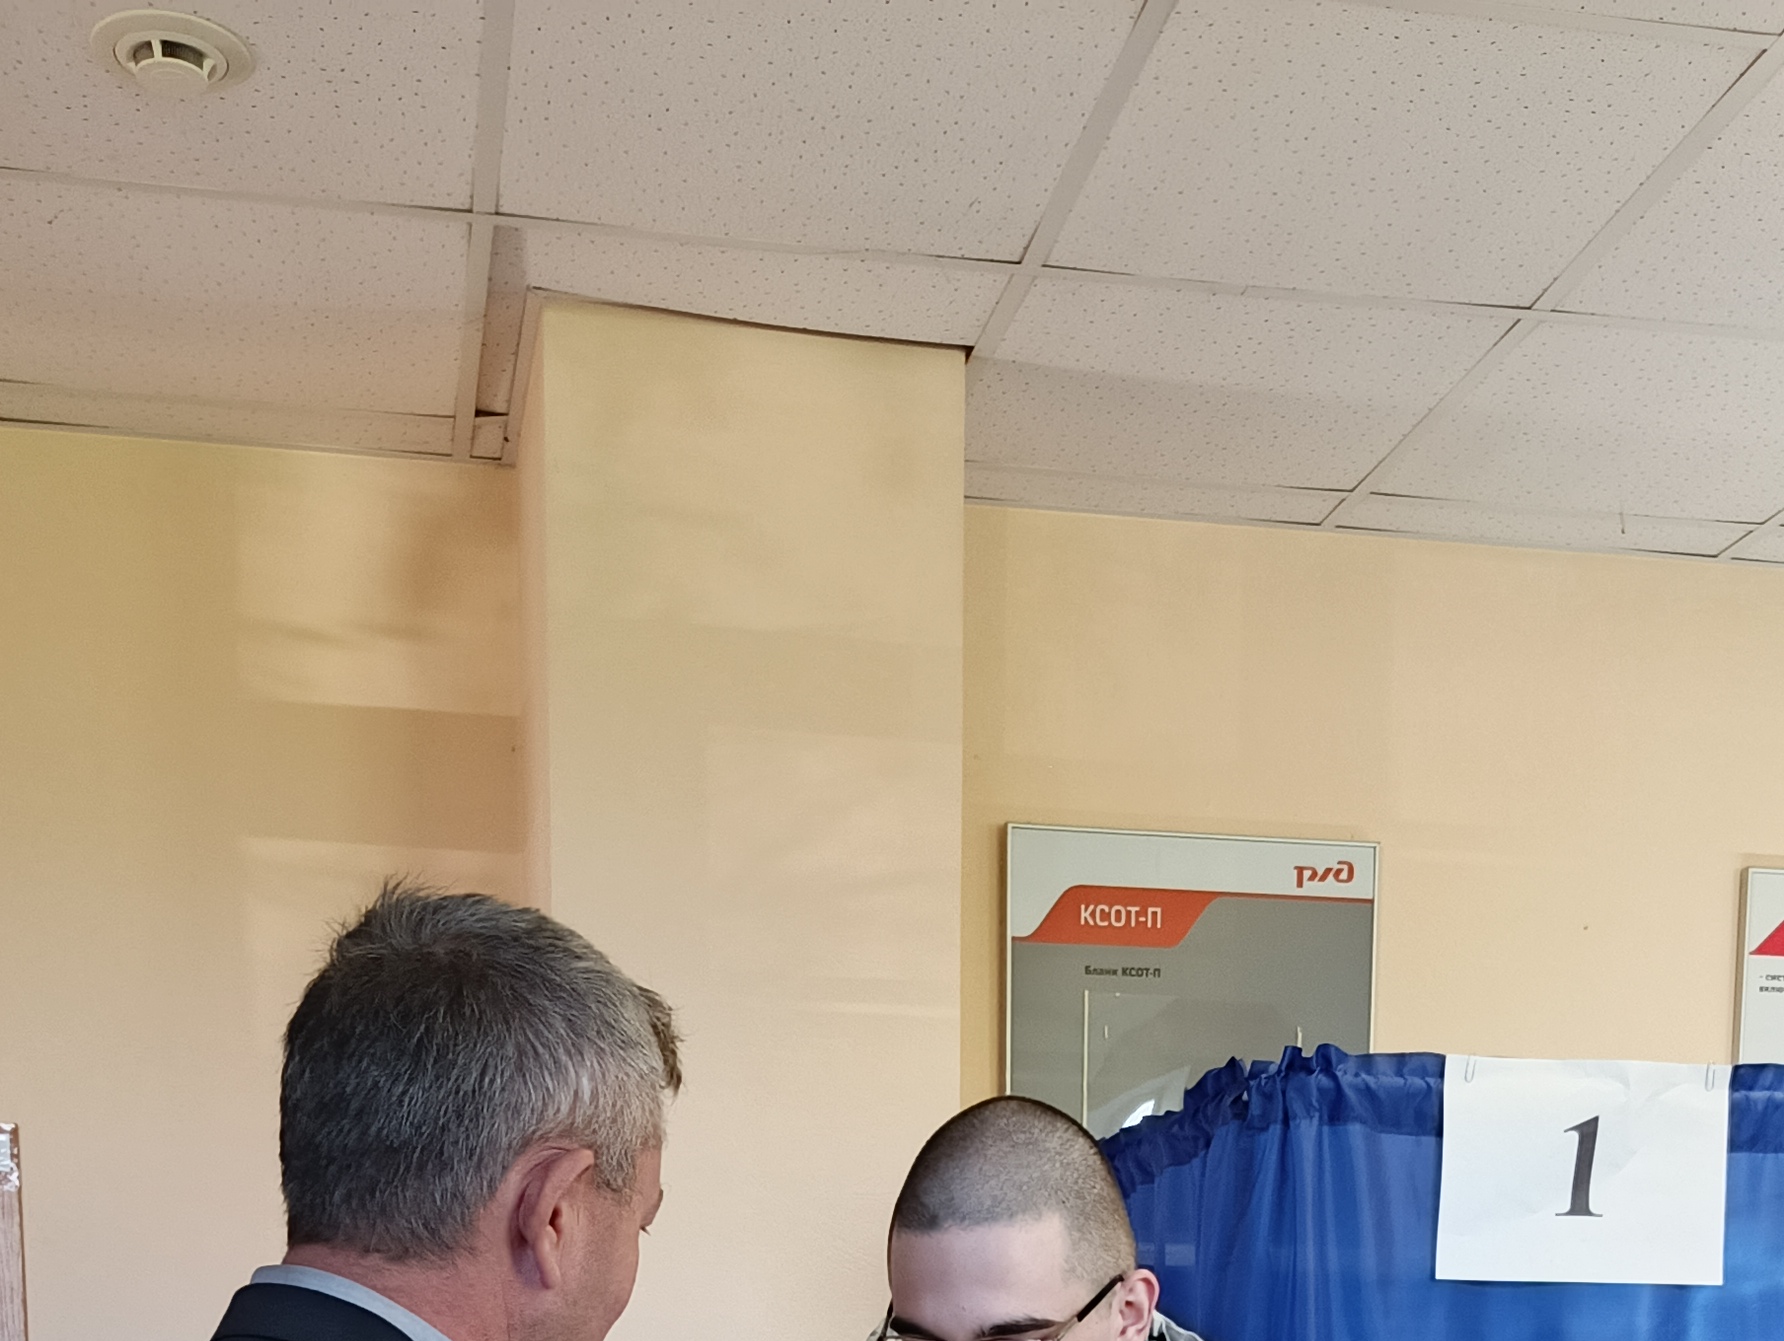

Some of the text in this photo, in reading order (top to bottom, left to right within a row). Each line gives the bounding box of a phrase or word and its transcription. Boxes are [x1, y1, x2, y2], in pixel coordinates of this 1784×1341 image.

[1080, 904, 1162, 929] КСОТ-П
[1084, 965, 1161, 978] Бланк КСОТ-П
[1555, 1115, 1603, 1217] 1
